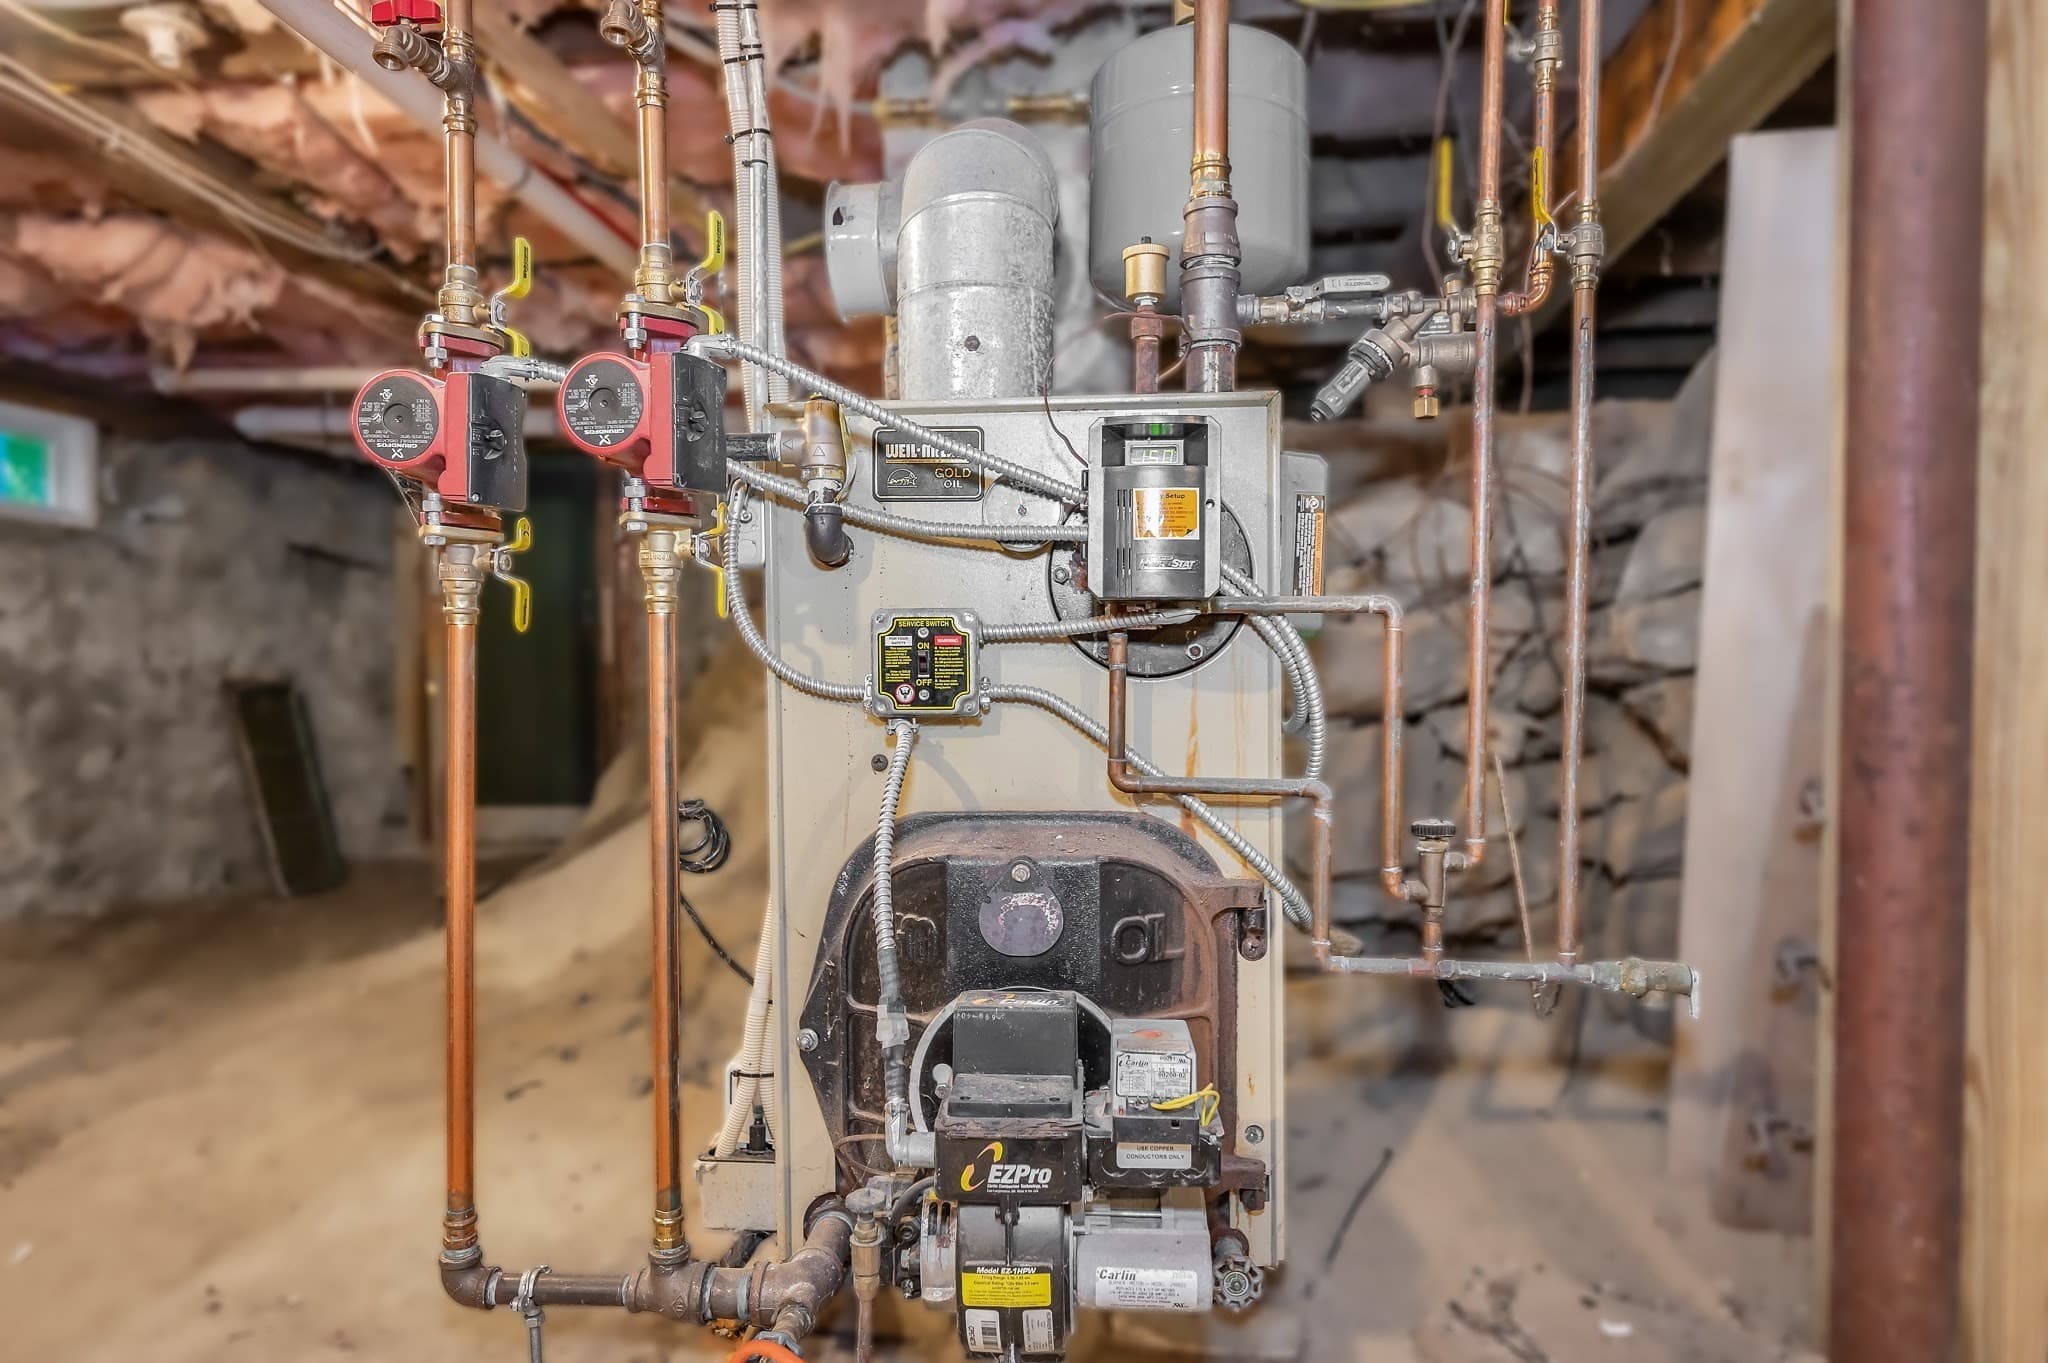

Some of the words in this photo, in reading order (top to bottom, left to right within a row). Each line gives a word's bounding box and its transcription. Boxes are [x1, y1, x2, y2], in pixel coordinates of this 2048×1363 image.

[934, 468, 972, 478] GOLD
[943, 480, 963, 488] OIL
[917, 642, 930, 650] ON
[915, 679, 932, 687] OFF
[987, 1164, 1052, 1184] EZPro
[1099, 1269, 1136, 1280] Carlin
